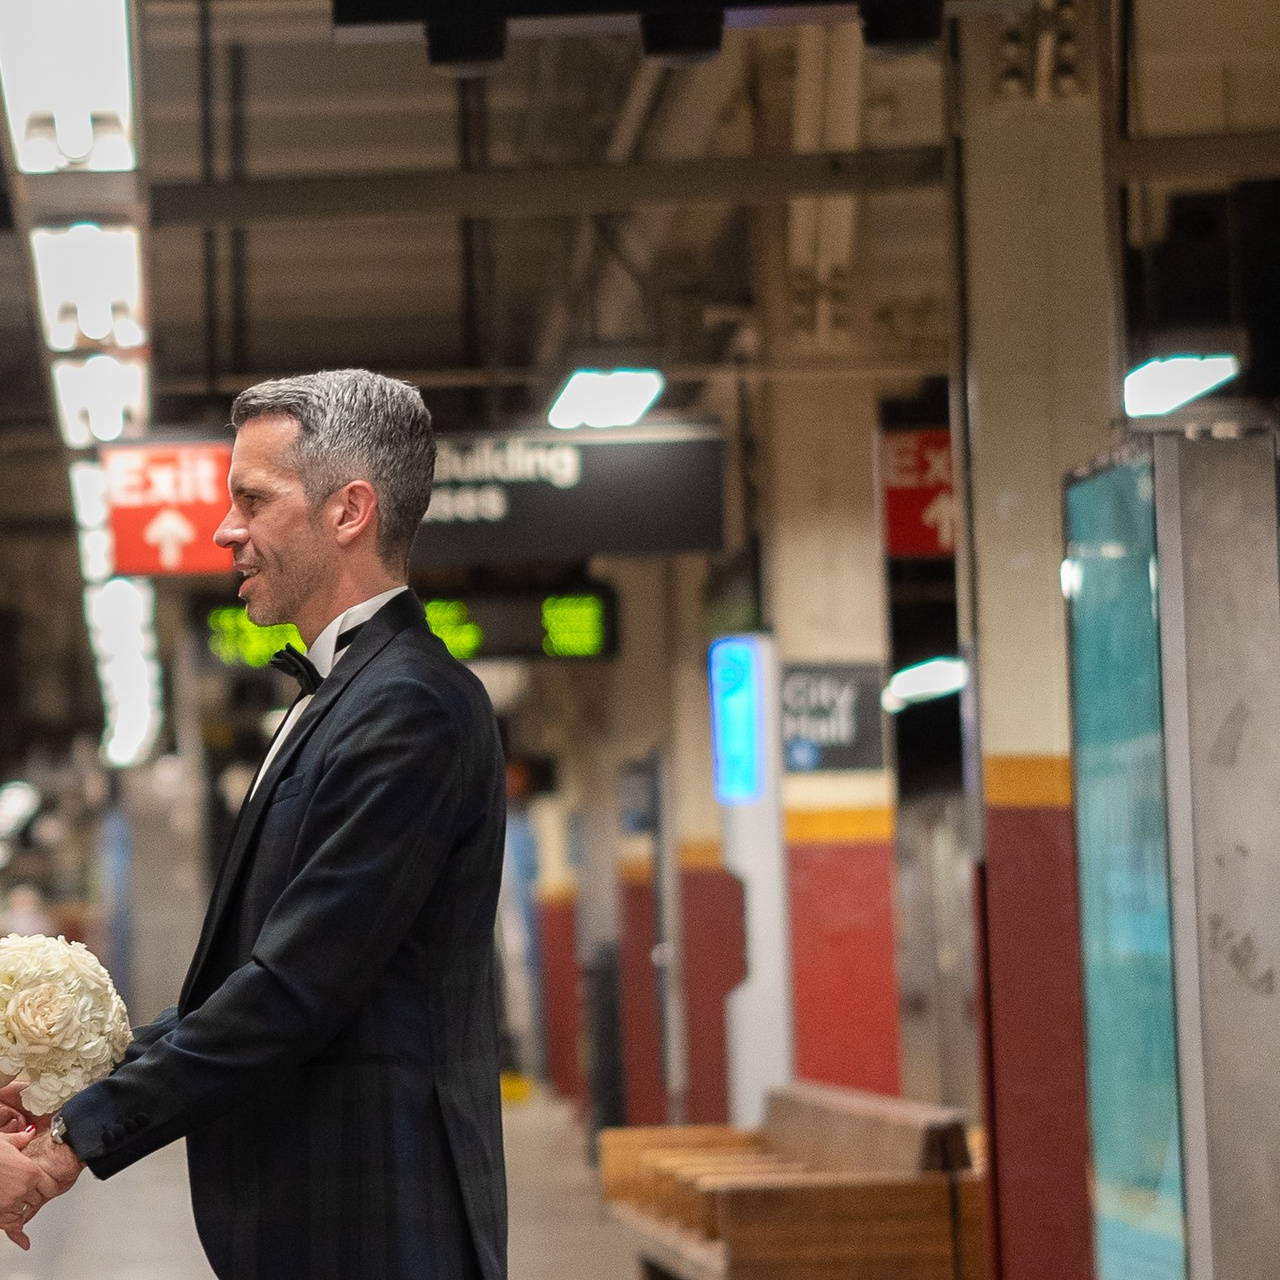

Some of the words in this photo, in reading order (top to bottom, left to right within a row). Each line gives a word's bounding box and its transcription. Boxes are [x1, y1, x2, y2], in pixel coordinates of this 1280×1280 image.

[104, 449, 217, 506] Exit
[879, 433, 952, 488] Ex
[782, 672, 855, 715] City
